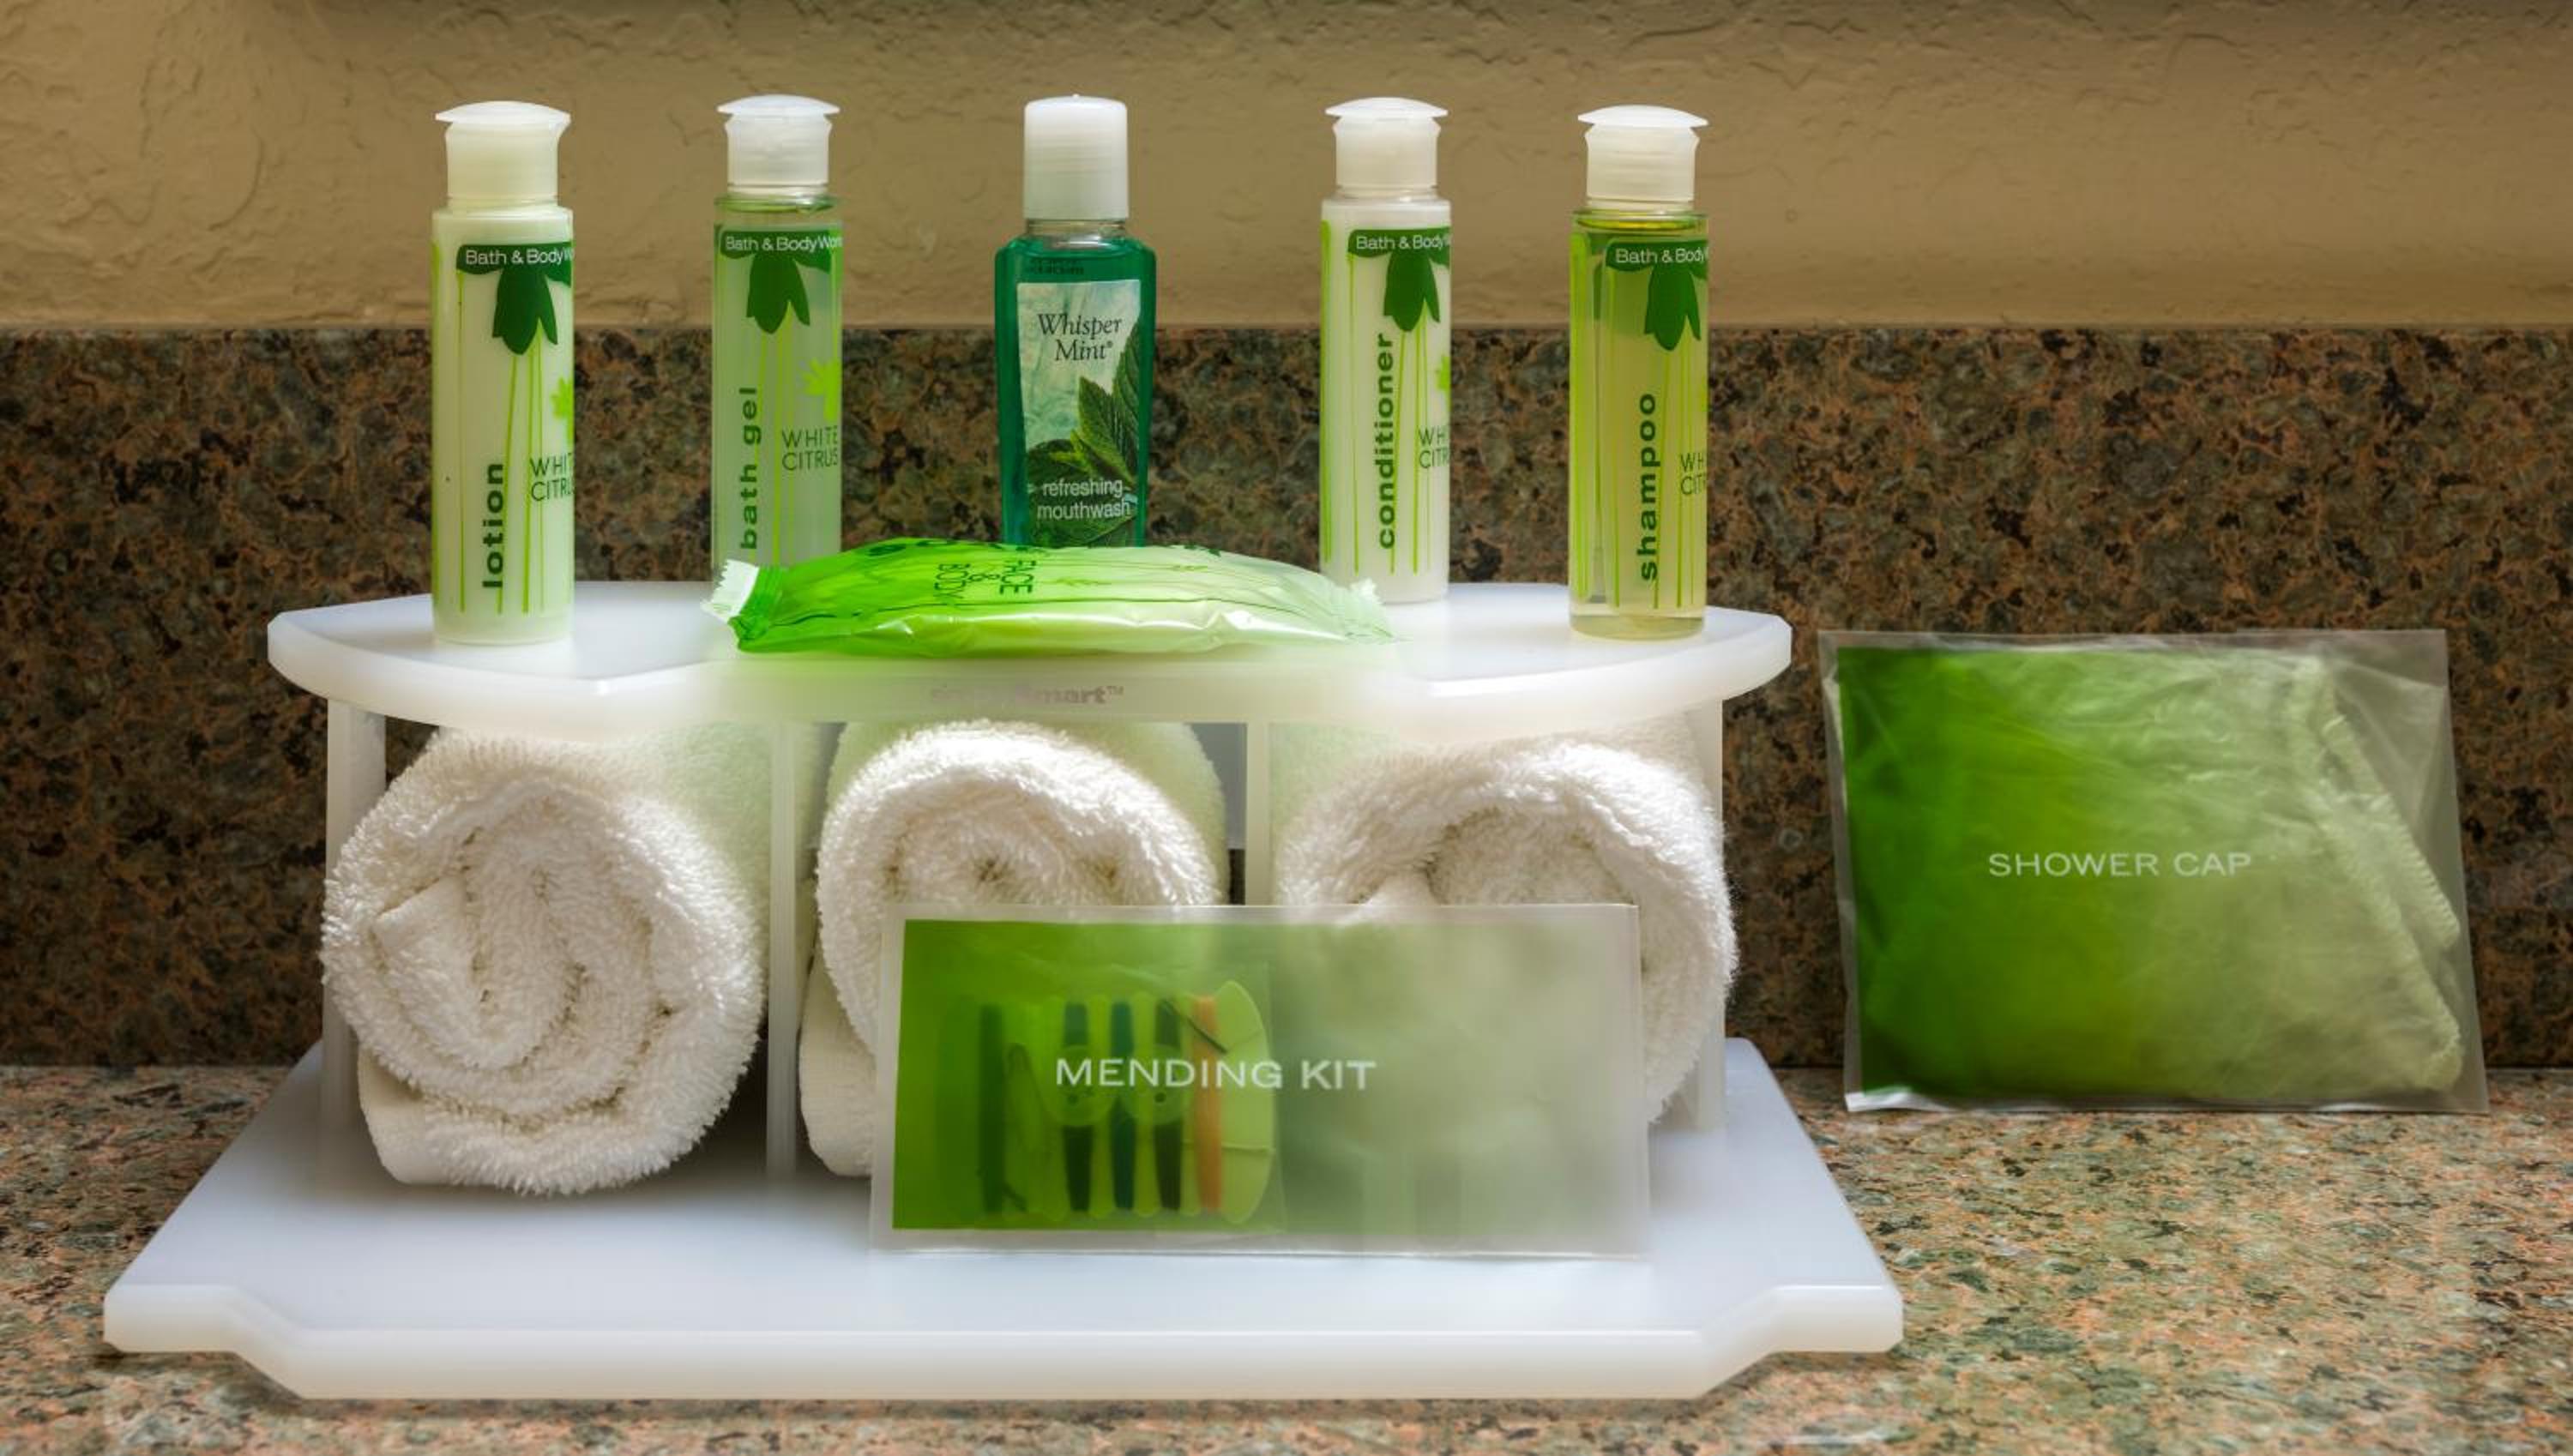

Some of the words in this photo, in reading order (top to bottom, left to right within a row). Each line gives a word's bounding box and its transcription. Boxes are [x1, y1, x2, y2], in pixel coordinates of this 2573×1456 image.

[726, 236, 759, 251] Bath
[762, 237, 774, 251] &
[1356, 236, 1395, 250] Bath
[1399, 236, 1411, 250] &
[466, 249, 507, 265] Bath
[510, 250, 524, 264] &
[1616, 248, 1657, 264] Bath
[1661, 249, 1673, 263] &
[1037, 312, 1123, 340] Whisper
[738, 388, 762, 445] gel
[1374, 333, 1395, 550] conditioner
[529, 452, 572, 476] WHIT
[531, 478, 575, 501] CITRU
[1042, 477, 1124, 498] refreshing
[1636, 394, 1660, 581] shampoo
[739, 464, 757, 550] bath
[1037, 497, 1130, 520] mouthwash
[482, 464, 504, 588] lotion
[1989, 852, 2159, 877] SHOWER
[2173, 851, 2251, 877] CAP
[1056, 1057, 1283, 1089] MENDING
[1300, 1059, 1377, 1090] KIT
